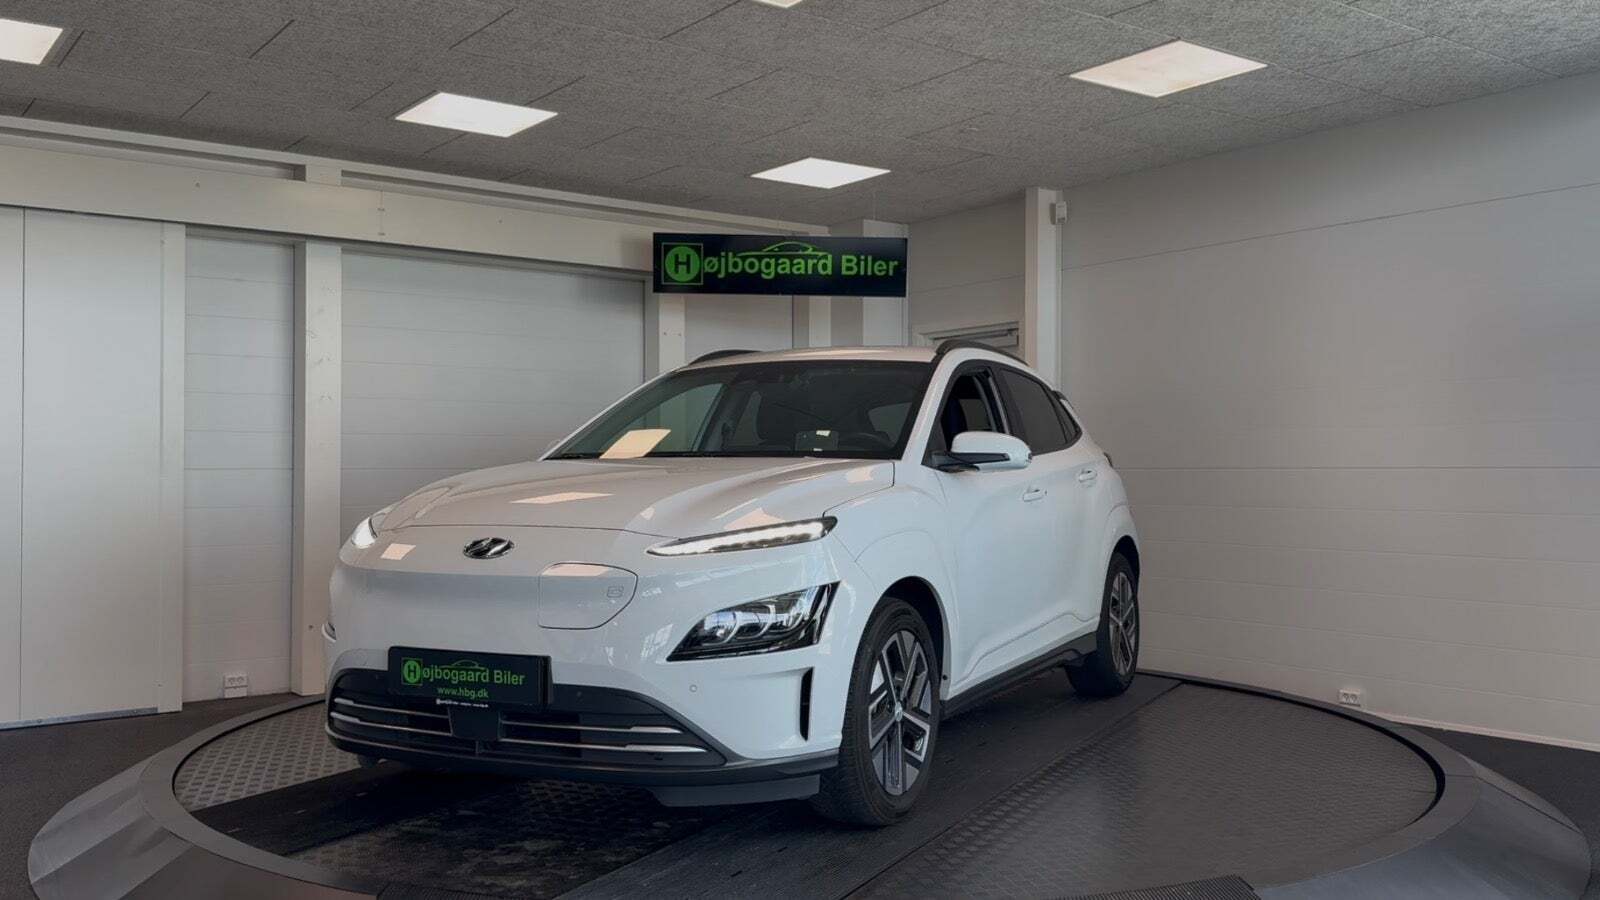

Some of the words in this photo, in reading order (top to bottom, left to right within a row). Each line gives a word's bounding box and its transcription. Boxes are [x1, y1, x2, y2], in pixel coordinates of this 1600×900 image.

[841, 254, 898, 276] Biler
[493, 669, 525, 685] Biler
[437, 687, 489, 699] www.hbg.dk
